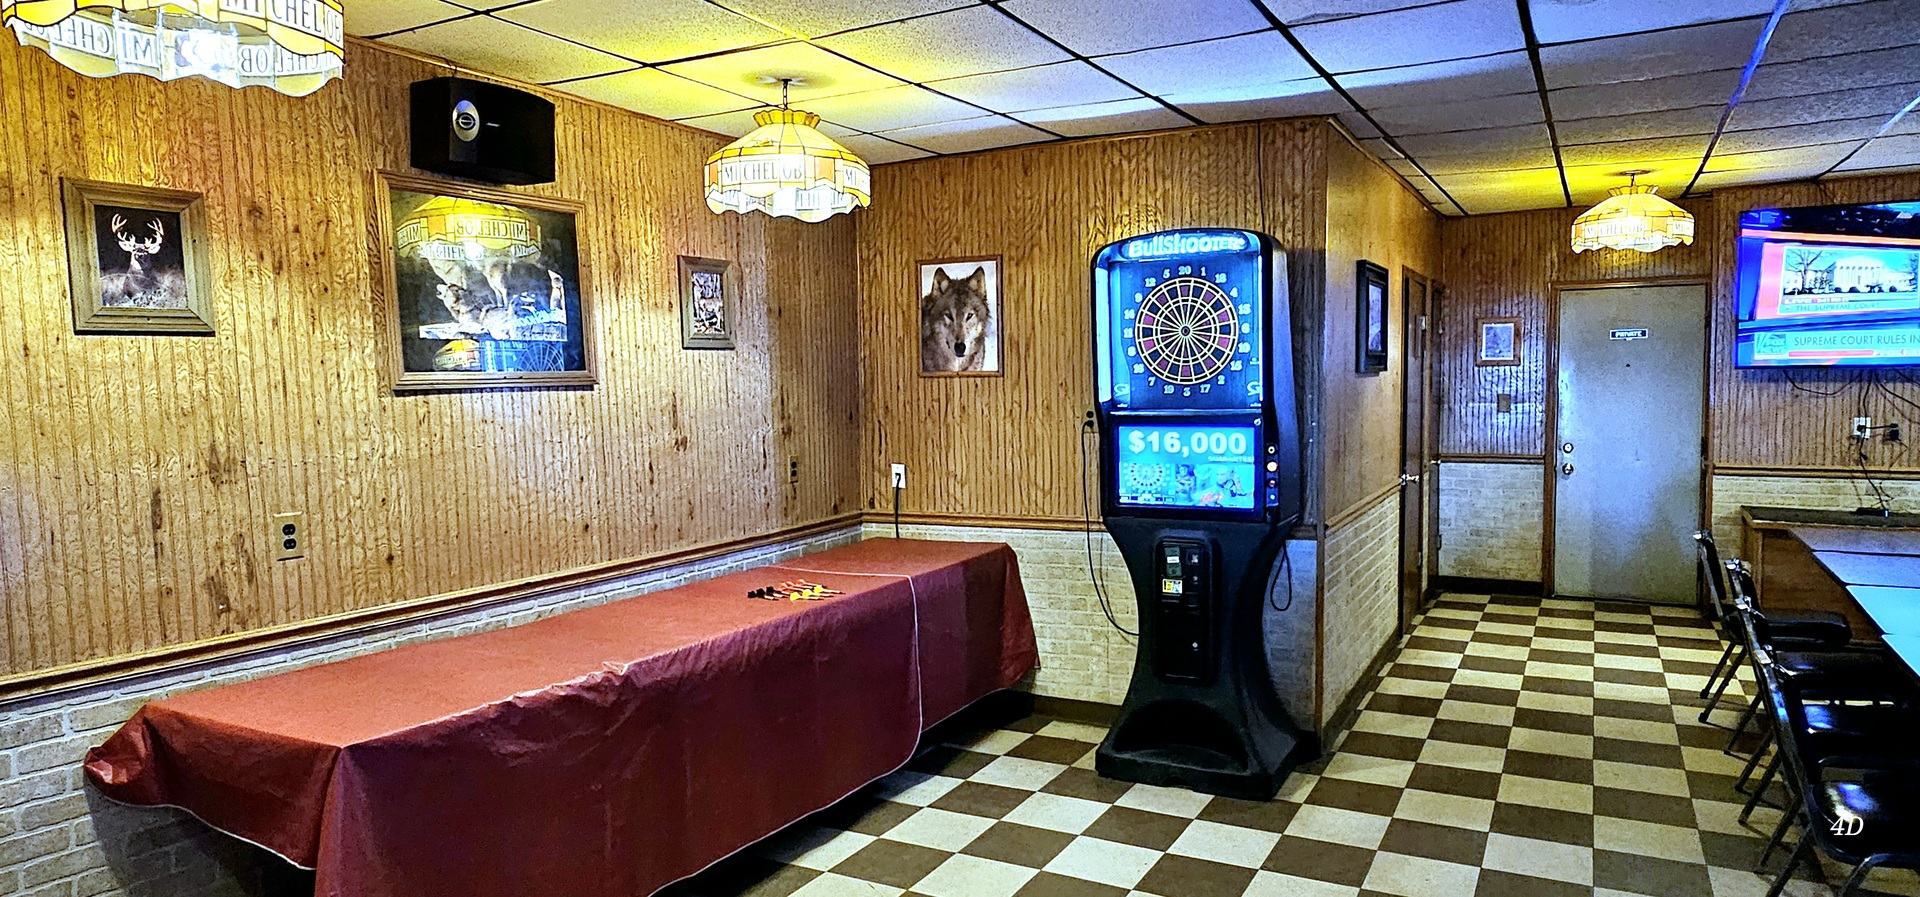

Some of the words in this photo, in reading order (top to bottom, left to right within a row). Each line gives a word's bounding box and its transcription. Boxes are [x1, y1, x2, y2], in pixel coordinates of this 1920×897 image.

[724, 161, 802, 182] MICHELOB
[1178, 265, 1191, 275] 20
[1200, 266, 1206, 276] 1
[1794, 336, 1838, 346] SUPREME
[1842, 335, 1874, 345] COURT
[1877, 334, 1907, 344] RULES
[1200, 384, 1211, 393] 17
[1128, 430, 1247, 458] $16,000
